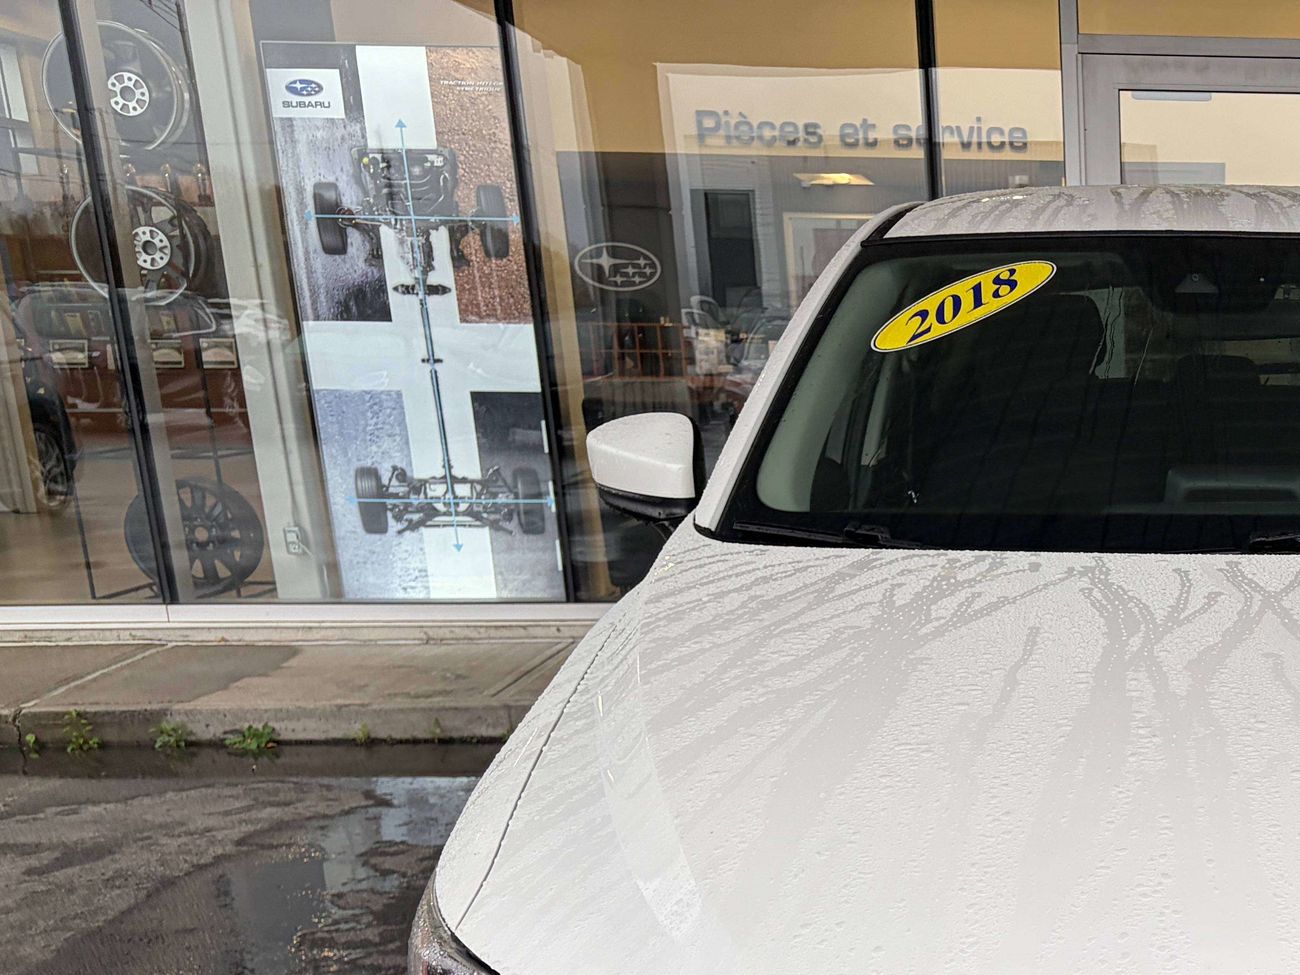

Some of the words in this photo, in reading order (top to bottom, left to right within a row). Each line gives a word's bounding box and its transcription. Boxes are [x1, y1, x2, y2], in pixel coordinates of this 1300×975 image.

[282, 100, 331, 109] SUBARU
[694, 109, 823, 148] Pièces
[838, 117, 879, 149] et
[905, 267, 1019, 345] 2018
